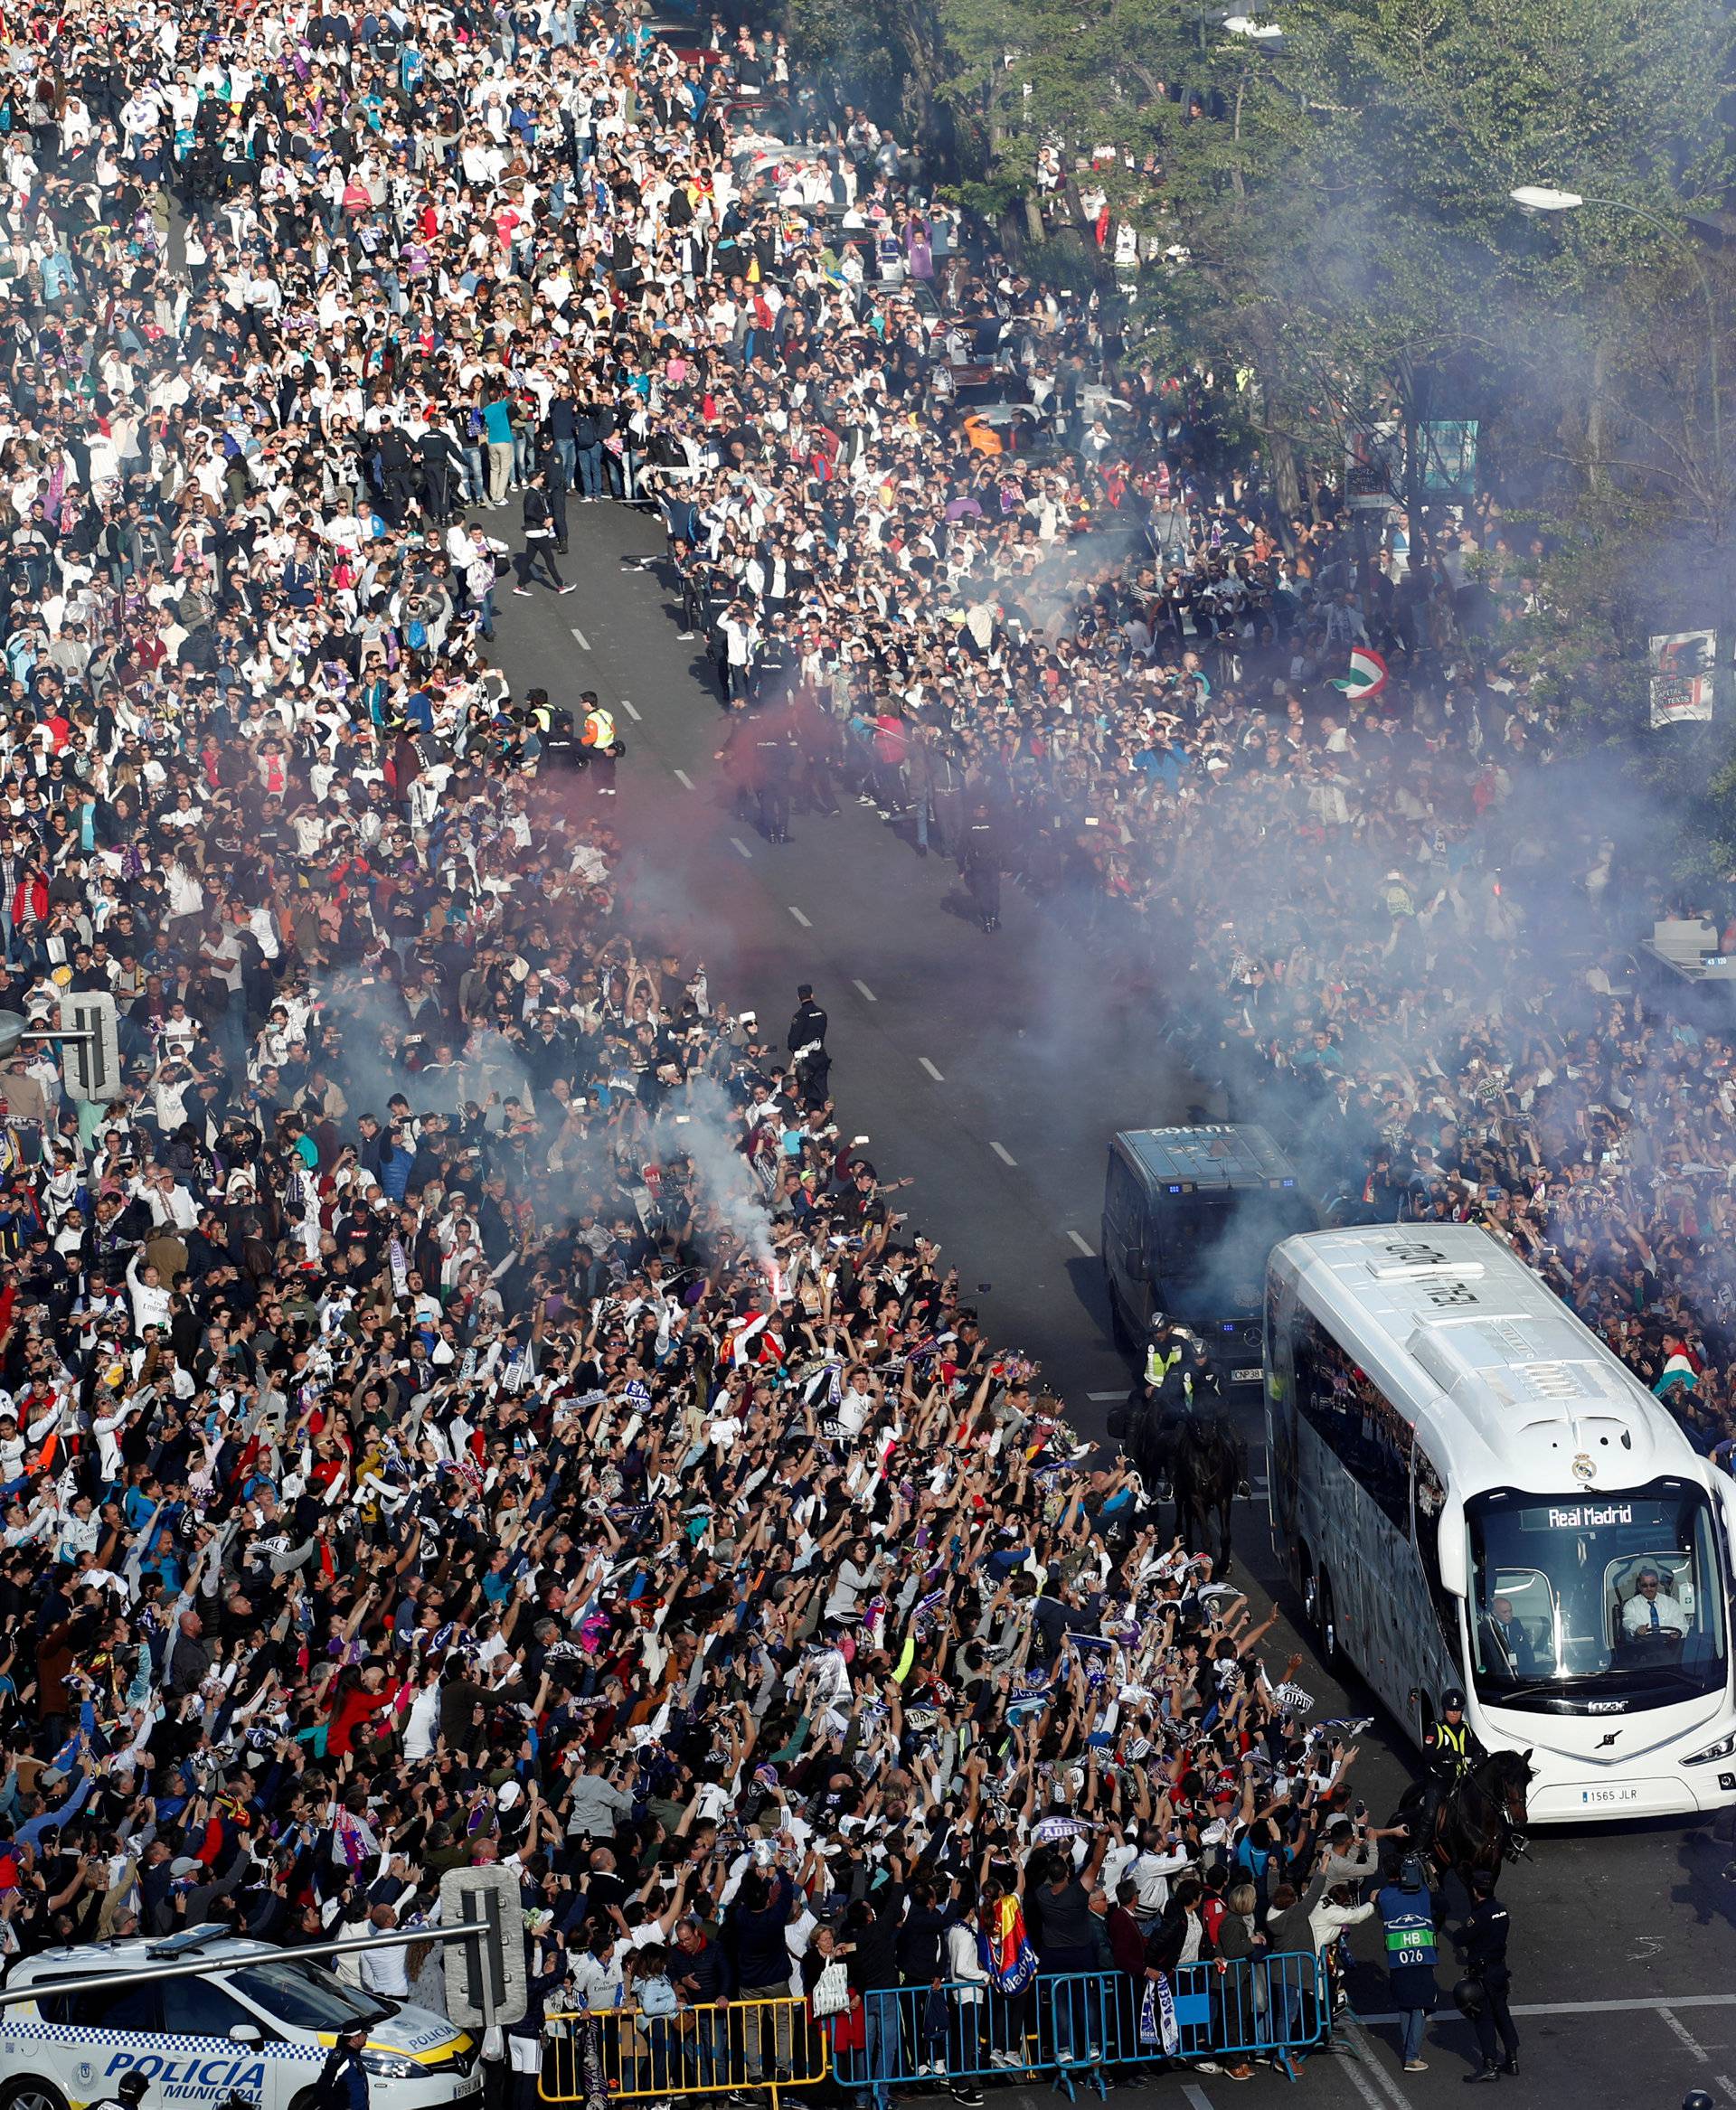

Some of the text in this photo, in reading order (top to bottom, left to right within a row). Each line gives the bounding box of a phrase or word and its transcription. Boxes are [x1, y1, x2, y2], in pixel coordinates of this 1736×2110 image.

[1549, 1505, 1632, 1528] Real Madrid
[1591, 1789, 1637, 1802] 1565 JLR
[1403, 1932, 1420, 1945] HB
[1399, 1950, 1423, 1964] 026
[104, 2052, 265, 2088] POLICÍA
[591, 2070, 603, 2090] REAL
